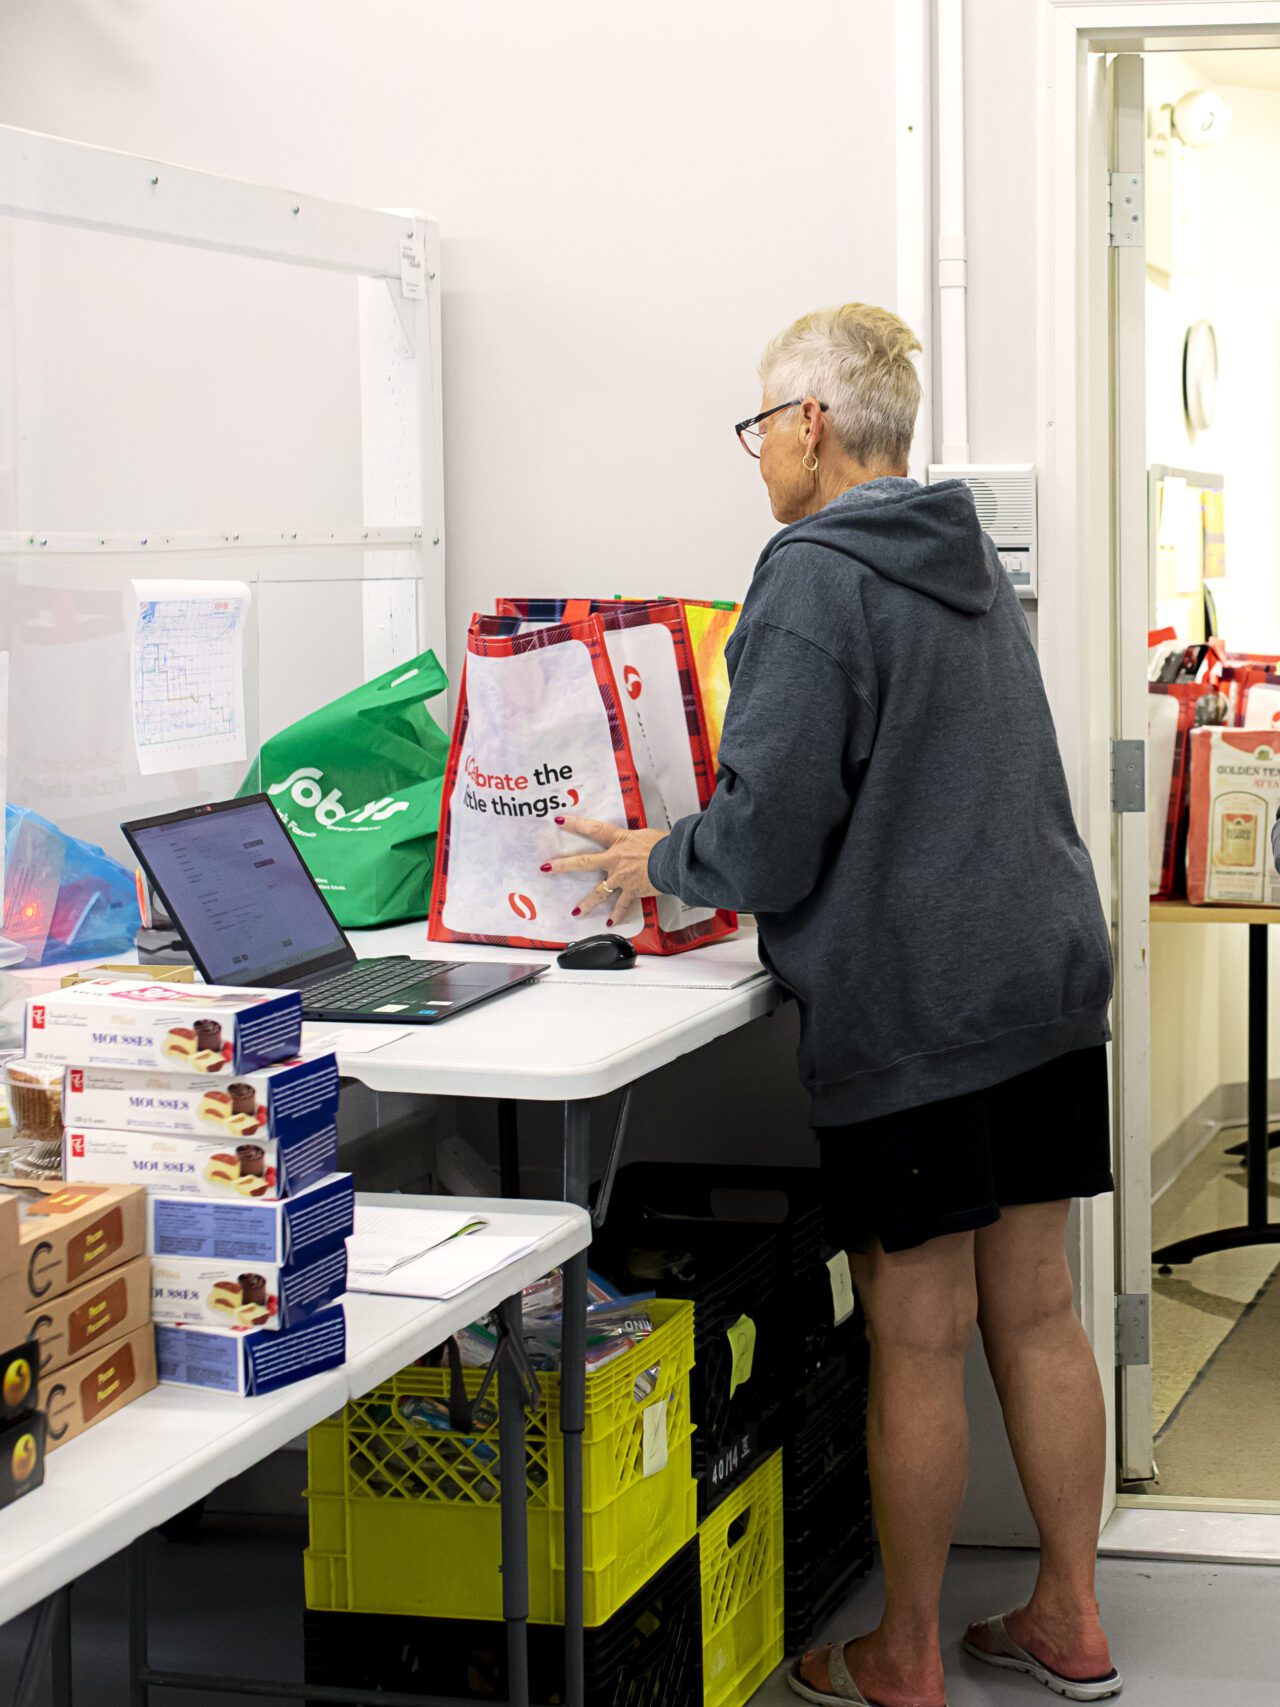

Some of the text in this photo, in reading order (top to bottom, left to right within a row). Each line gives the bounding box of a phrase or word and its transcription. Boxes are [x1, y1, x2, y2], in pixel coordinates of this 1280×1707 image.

[533, 763, 573, 786] the
[1216, 765, 1260, 776] GOLDEN
[267, 767, 410, 826] Sobys
[92, 1033, 153, 1047] MOUSSES
[129, 1096, 189, 1110] MOUSSES
[132, 1160, 195, 1173] MOUSSES
